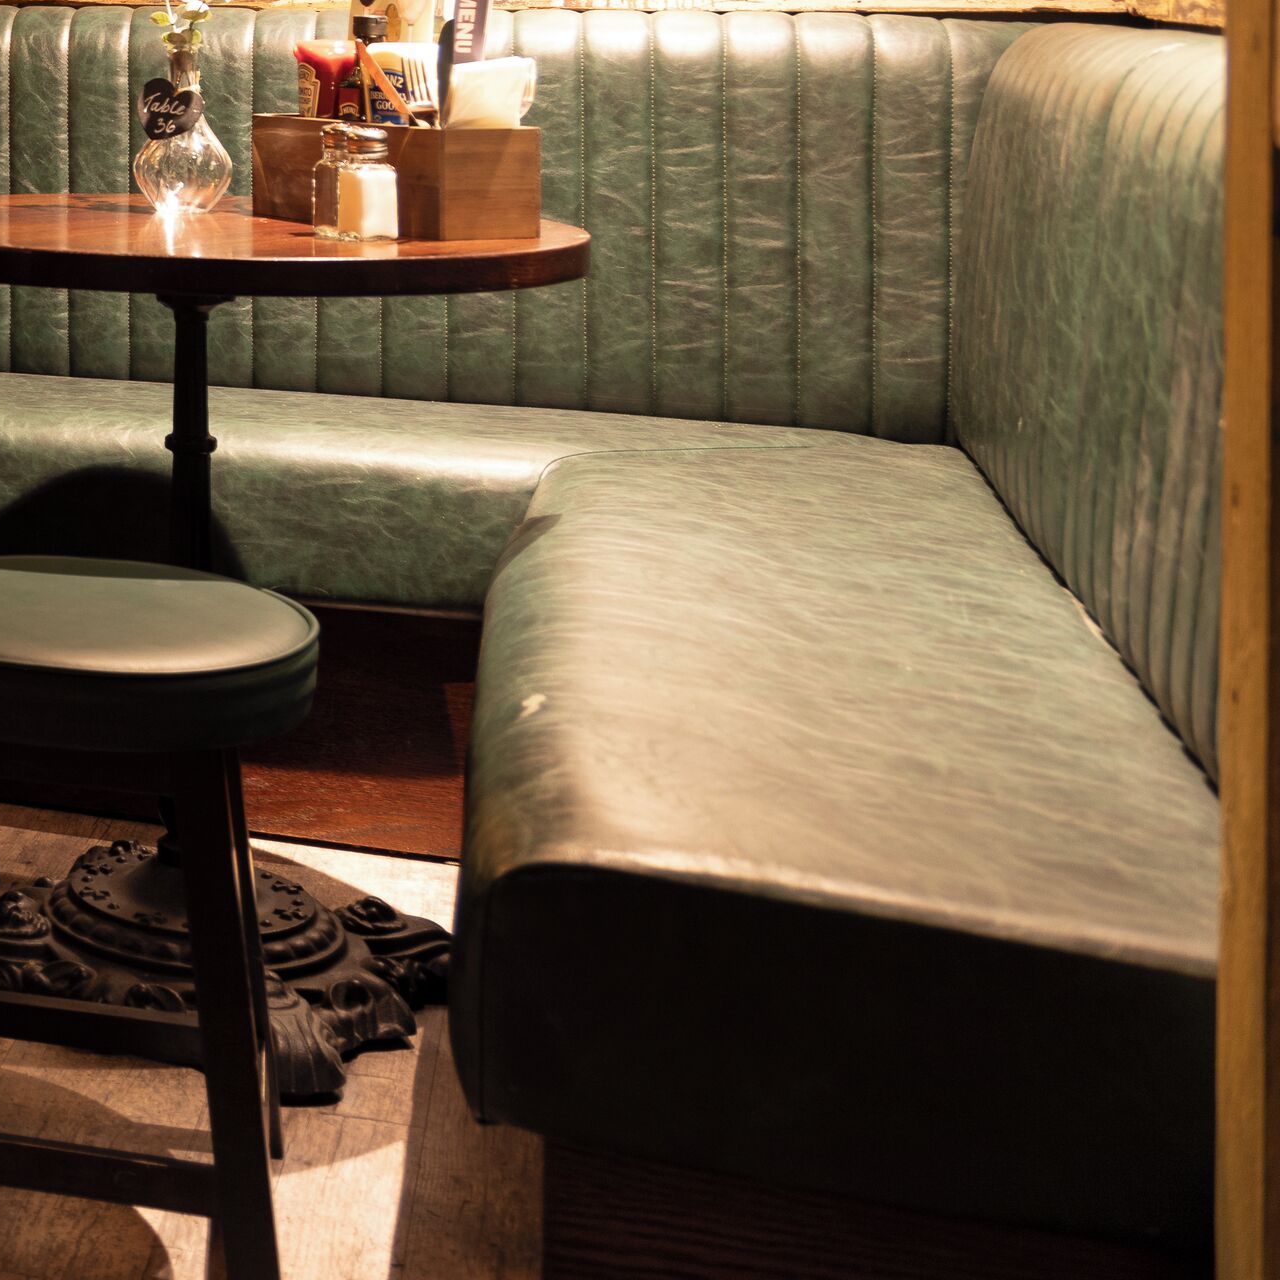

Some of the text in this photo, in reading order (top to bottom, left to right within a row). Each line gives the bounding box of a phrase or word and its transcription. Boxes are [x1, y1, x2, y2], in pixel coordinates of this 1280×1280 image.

[144, 92, 186, 115] Table
[376, 100, 396, 111] GOO
[154, 118, 176, 133] 36
